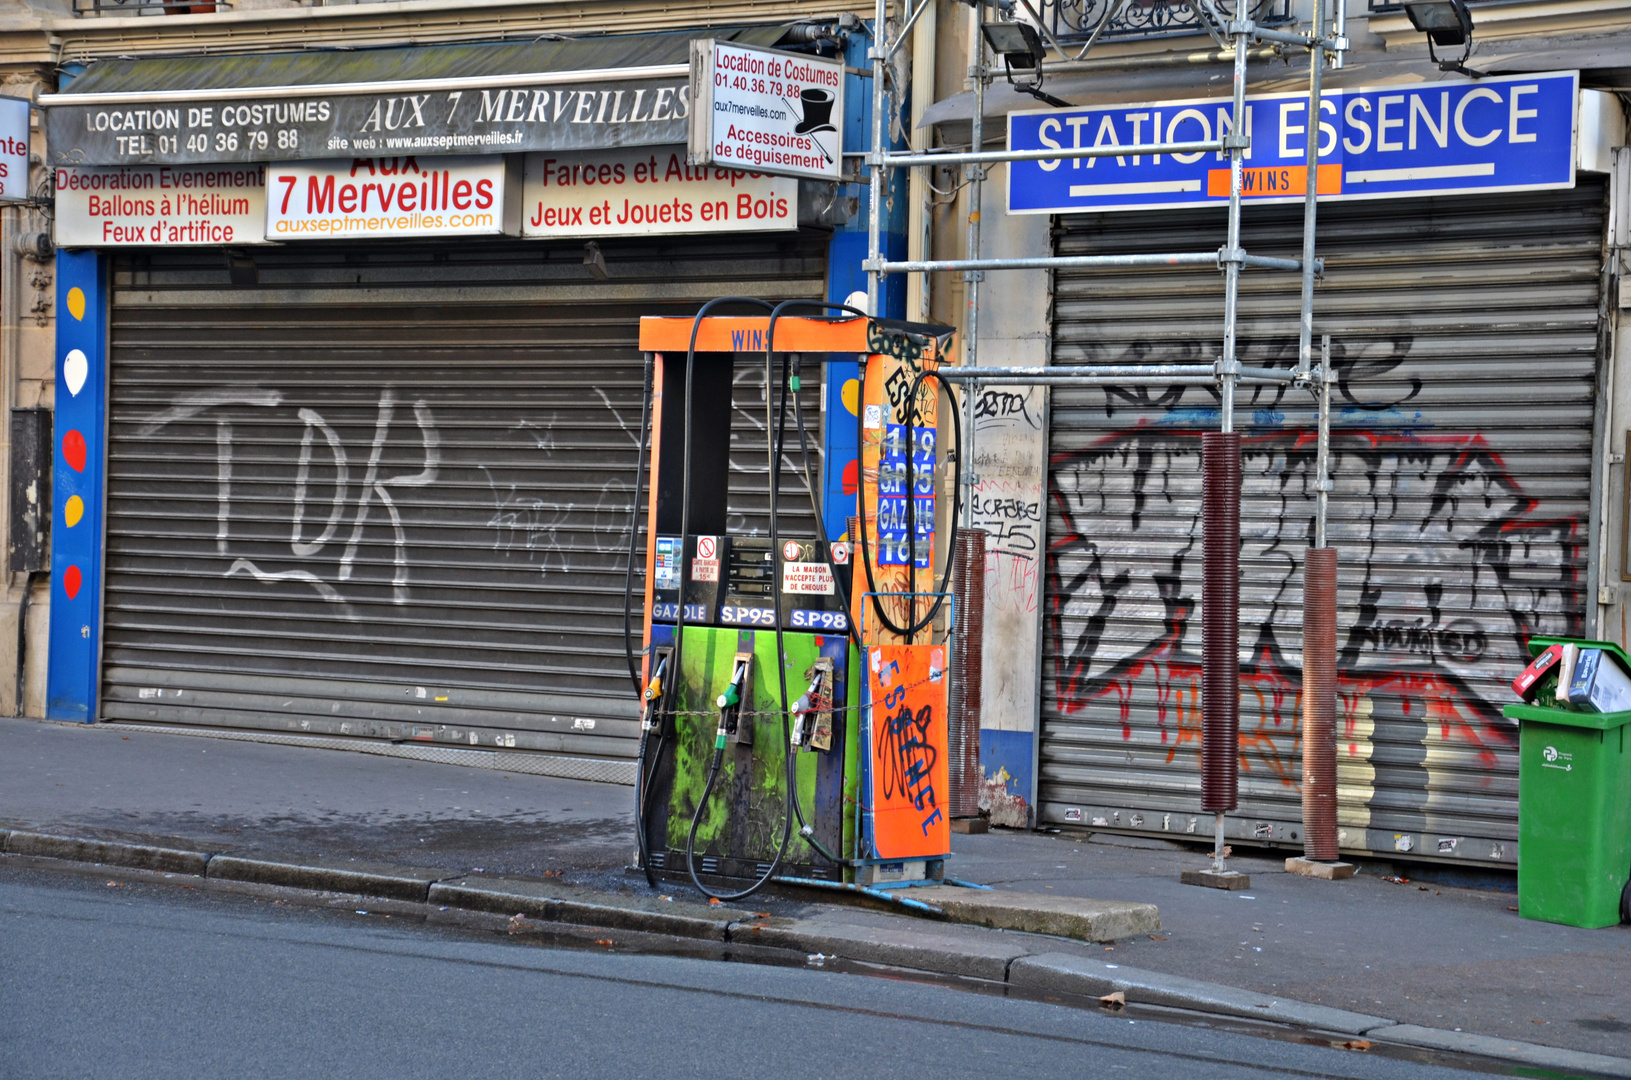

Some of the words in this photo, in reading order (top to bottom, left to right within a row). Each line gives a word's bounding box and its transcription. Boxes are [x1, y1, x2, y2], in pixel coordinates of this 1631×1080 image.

[716, 48, 765, 75] Location
[767, 57, 782, 78] de
[784, 59, 839, 87] Costumes
[715, 72, 800, 99] 01.40.36.79.88
[86, 109, 179, 131] LOCATION
[188, 108, 213, 128] DE
[221, 101, 330, 127] COSTUMES
[359, 94, 431, 132] AUX
[446, 91, 463, 125] 7
[474, 85, 690, 124] MERVEILLES
[714, 101, 787, 121] aux7merveilles.com
[327, 136, 348, 150] site
[353, 135, 376, 149] web
[386, 130, 524, 149] www.auxseptmerveilles.fr
[727, 124, 812, 150] Accessoires
[1037, 105, 1253, 172] STATION
[1279, 84, 1539, 158] ESSENCE
[116, 135, 153, 155] TEL
[158, 135, 177, 154] 01
[186, 134, 208, 152] 40
[215, 132, 238, 152] 36
[247, 131, 268, 150] 79
[277, 129, 298, 149] 88
[350, 155, 420, 177] Aux
[715, 141, 732, 157] de
[736, 144, 825, 170] déguisement
[56, 168, 154, 190] Décoration
[160, 165, 265, 189] Evenement
[543, 158, 626, 187] Farces
[634, 155, 658, 184] et
[1242, 171, 1289, 191] WINS
[89, 195, 155, 216] Ballons
[160, 194, 171, 216] à
[177, 193, 249, 216] l'hélium
[278, 176, 297, 215] 7
[307, 170, 494, 214] Merveilles
[530, 201, 583, 227] Jeux
[589, 200, 611, 225] et
[616, 197, 693, 224] Jouets
[700, 200, 729, 222] en
[736, 191, 788, 219] Bois
[103, 221, 145, 242] Feux
[150, 220, 234, 242] d'artifice
[276, 213, 493, 235] auxseptmerveilles.com
[785, 574, 816, 582] N'ACCEPTE
[818, 575, 834, 583] PLUS
[792, 565, 800, 573] LA
[790, 583, 798, 591] DE
[801, 584, 828, 592] CHEQUES
[721, 606, 775, 625] S.P95
[792, 611, 847, 629] S.P98
